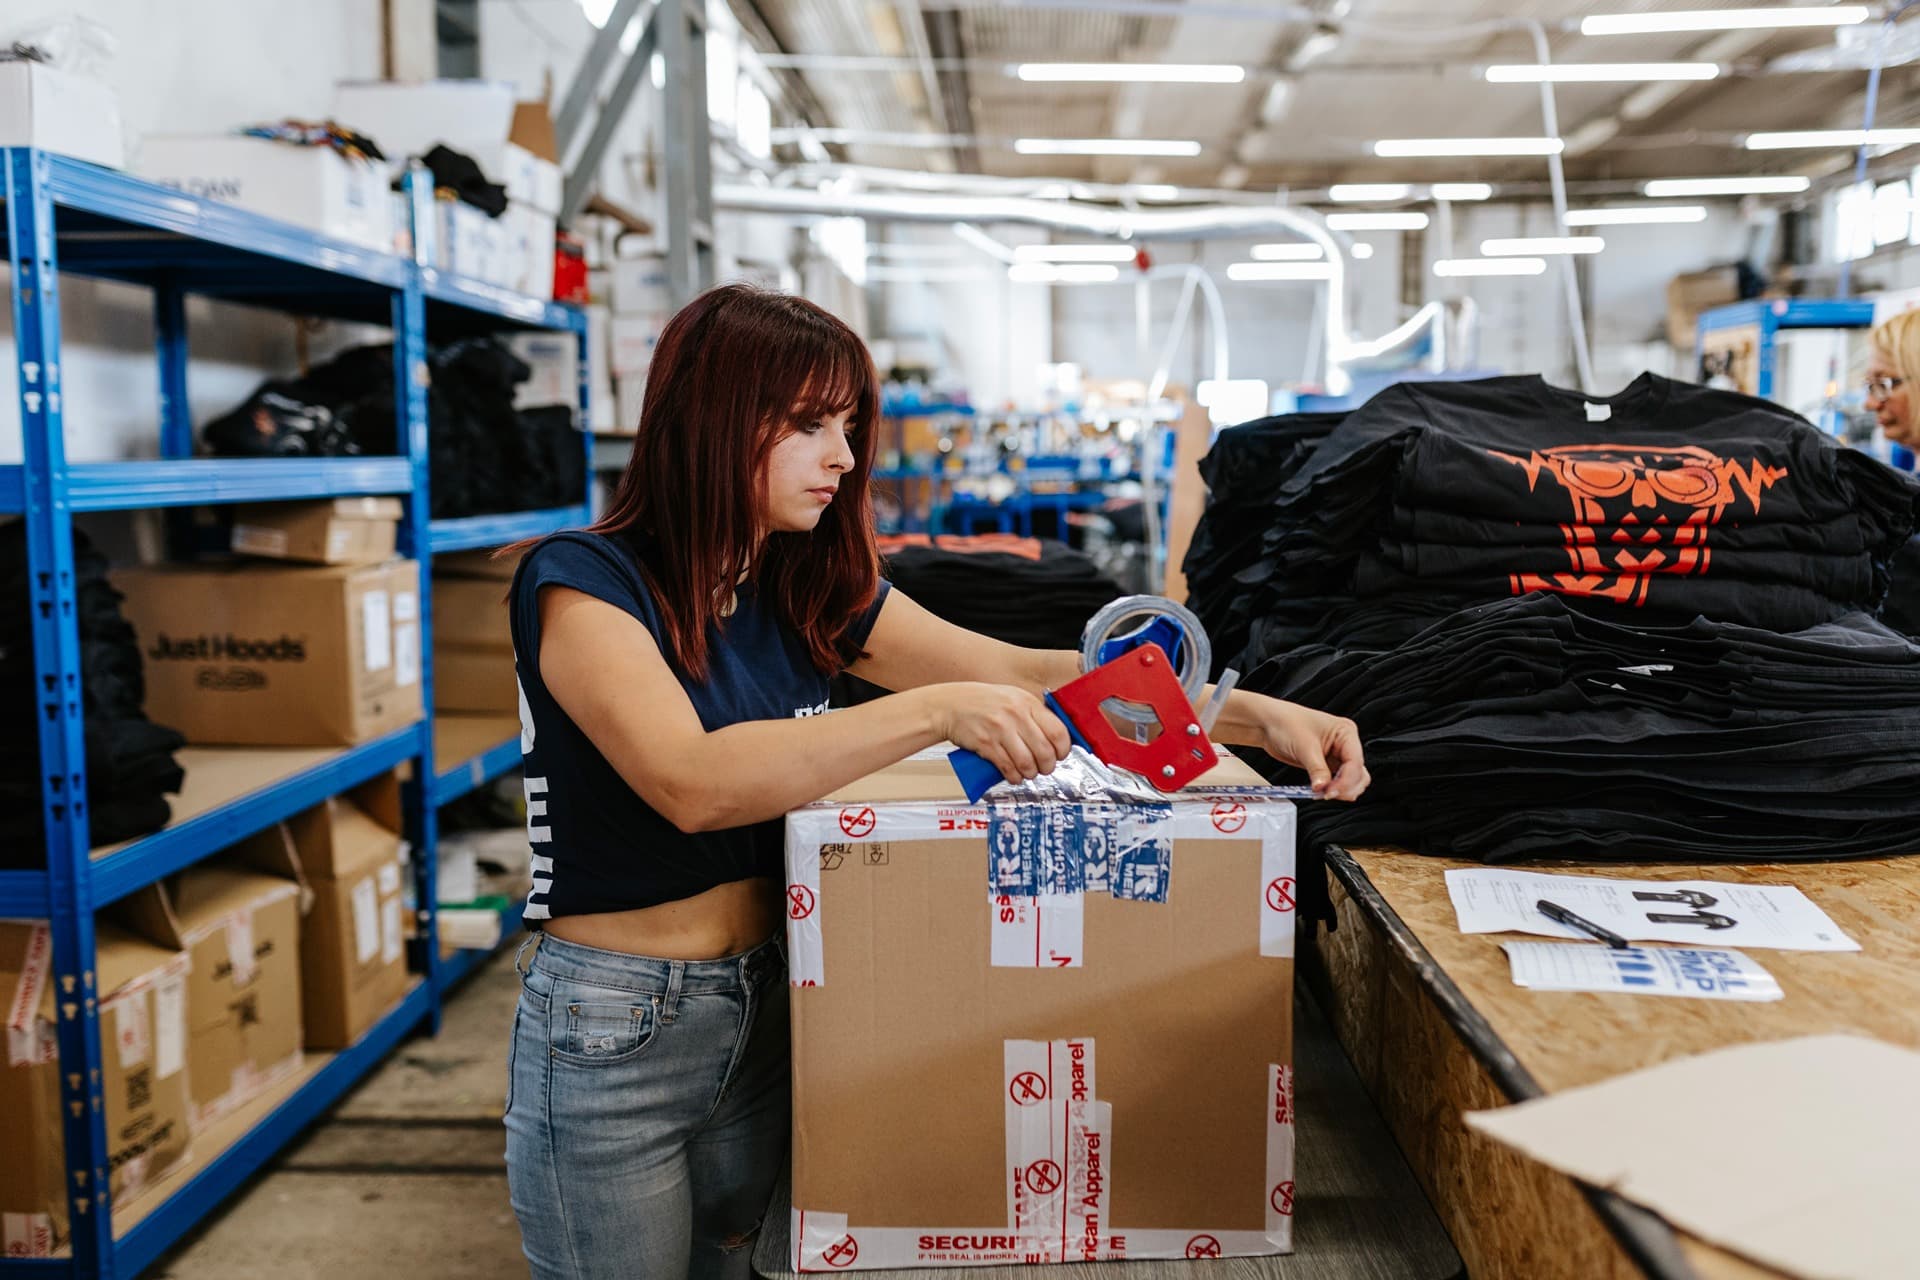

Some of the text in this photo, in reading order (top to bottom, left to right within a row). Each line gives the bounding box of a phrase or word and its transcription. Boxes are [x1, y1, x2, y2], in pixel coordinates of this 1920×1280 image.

[149, 632, 306, 662] Just Hoods
[939, 819, 989, 831] APE
[1082, 1133, 1101, 1208] Apparel
